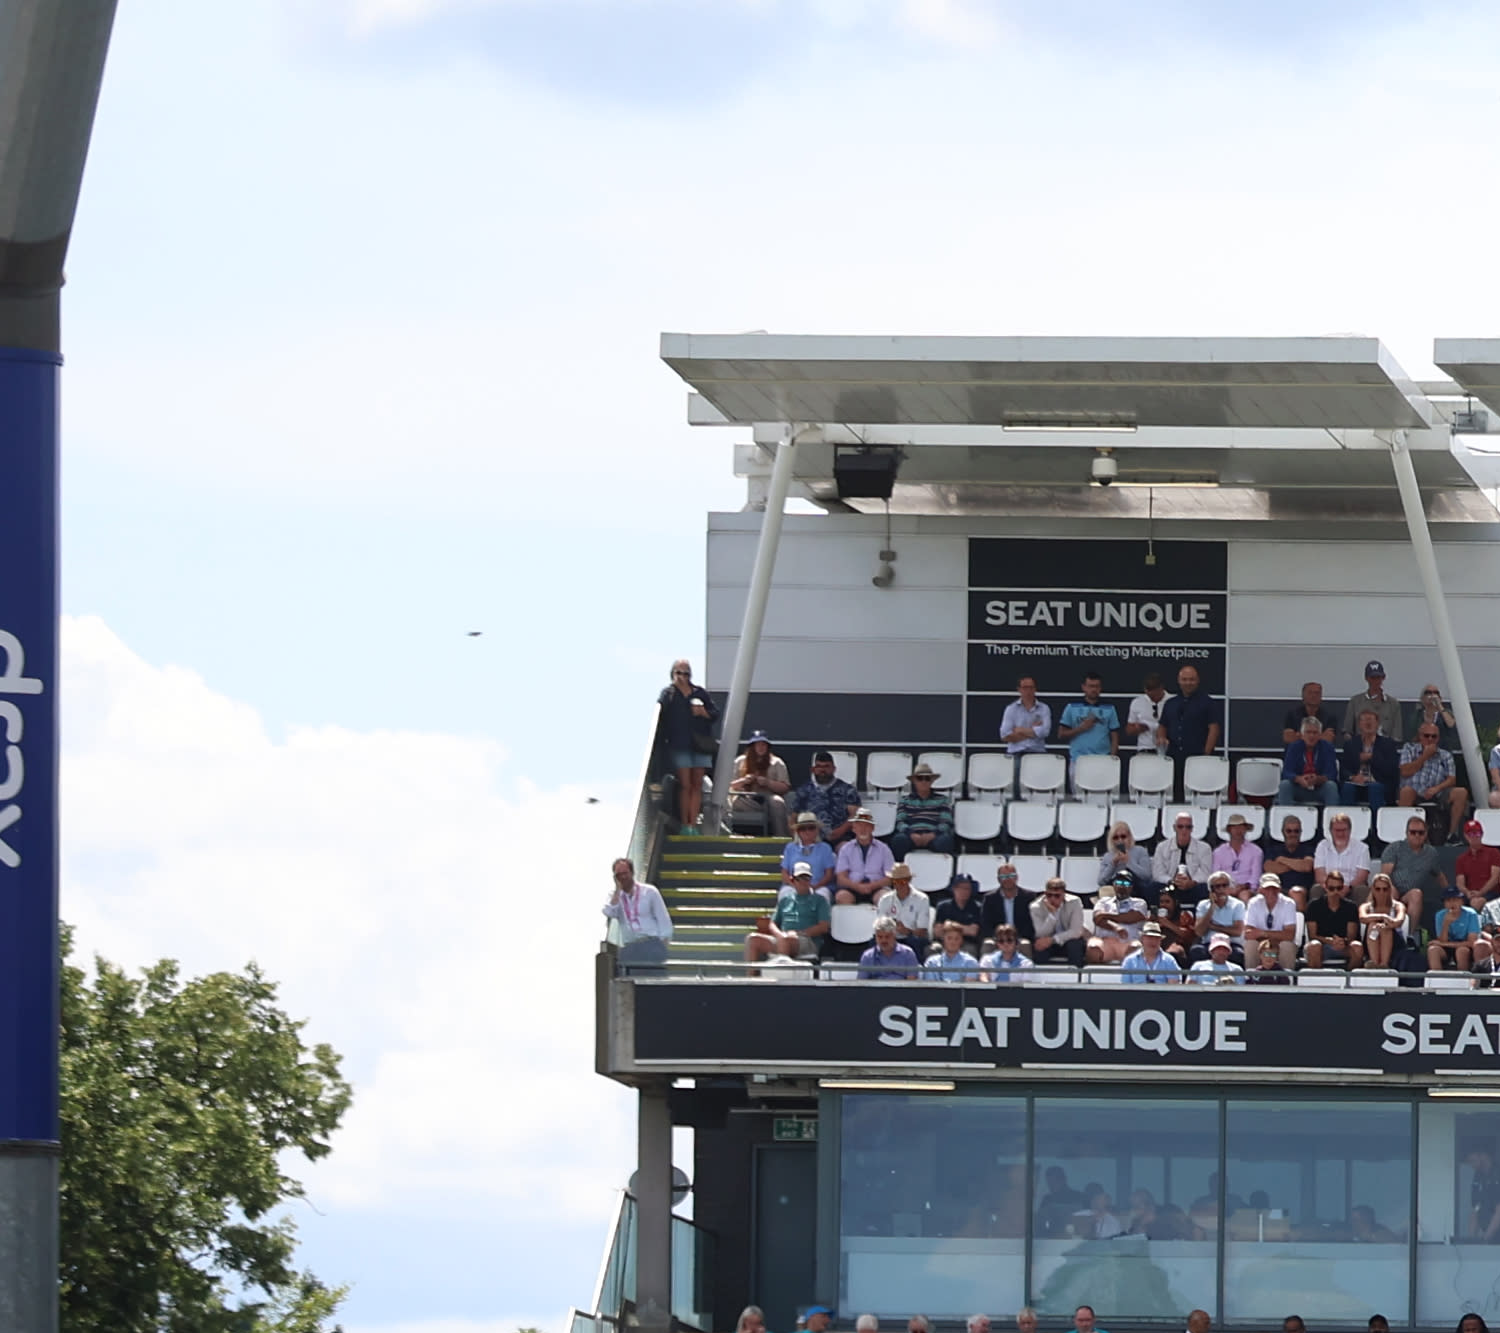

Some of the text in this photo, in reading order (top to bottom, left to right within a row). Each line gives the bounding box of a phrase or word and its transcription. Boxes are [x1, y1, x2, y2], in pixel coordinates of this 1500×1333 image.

[985, 600, 1211, 632] SEAT UNIQUE
[985, 644, 1210, 660] The Premium Ticketing Marketplace
[879, 1006, 1246, 1056] SEAT UNIQUE
